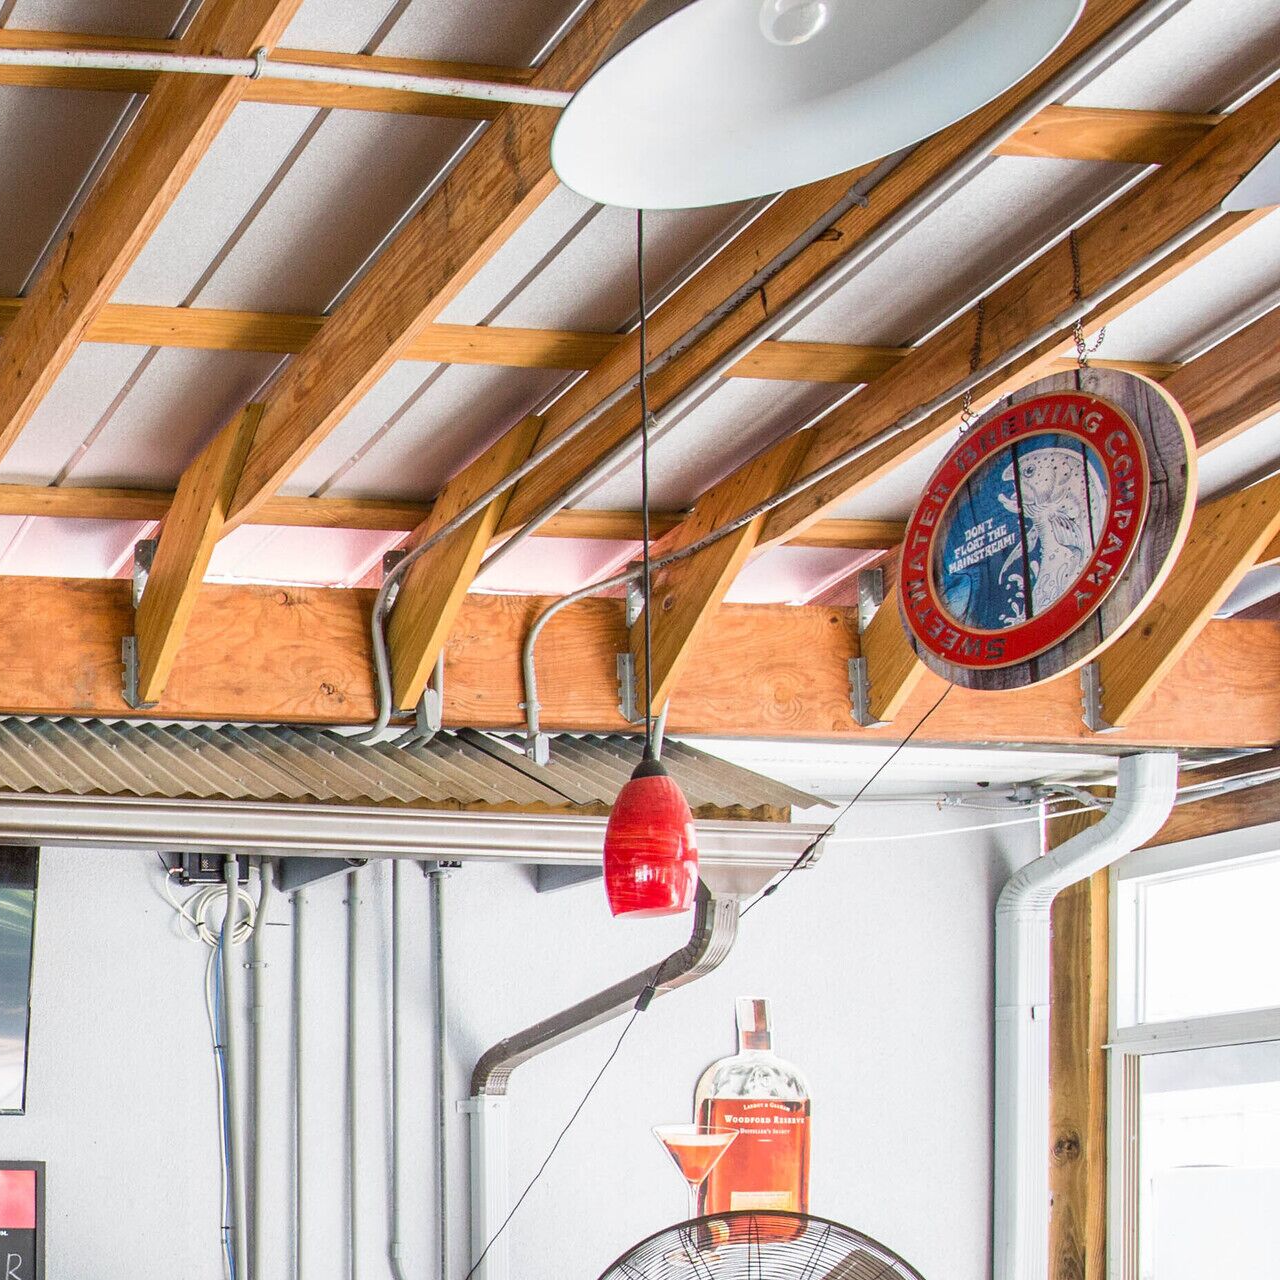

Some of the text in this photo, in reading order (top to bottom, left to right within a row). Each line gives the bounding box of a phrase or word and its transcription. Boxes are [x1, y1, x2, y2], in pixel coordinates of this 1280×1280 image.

[906, 403, 1136, 660] SWEETWATER BREWING COMPANY
[954, 524, 1008, 559] FLOAT THE
[964, 517, 994, 541] DON'T
[948, 532, 1017, 575] MAINSTREAM!
[724, 1114, 805, 1124] WOODFORD RESERVE
